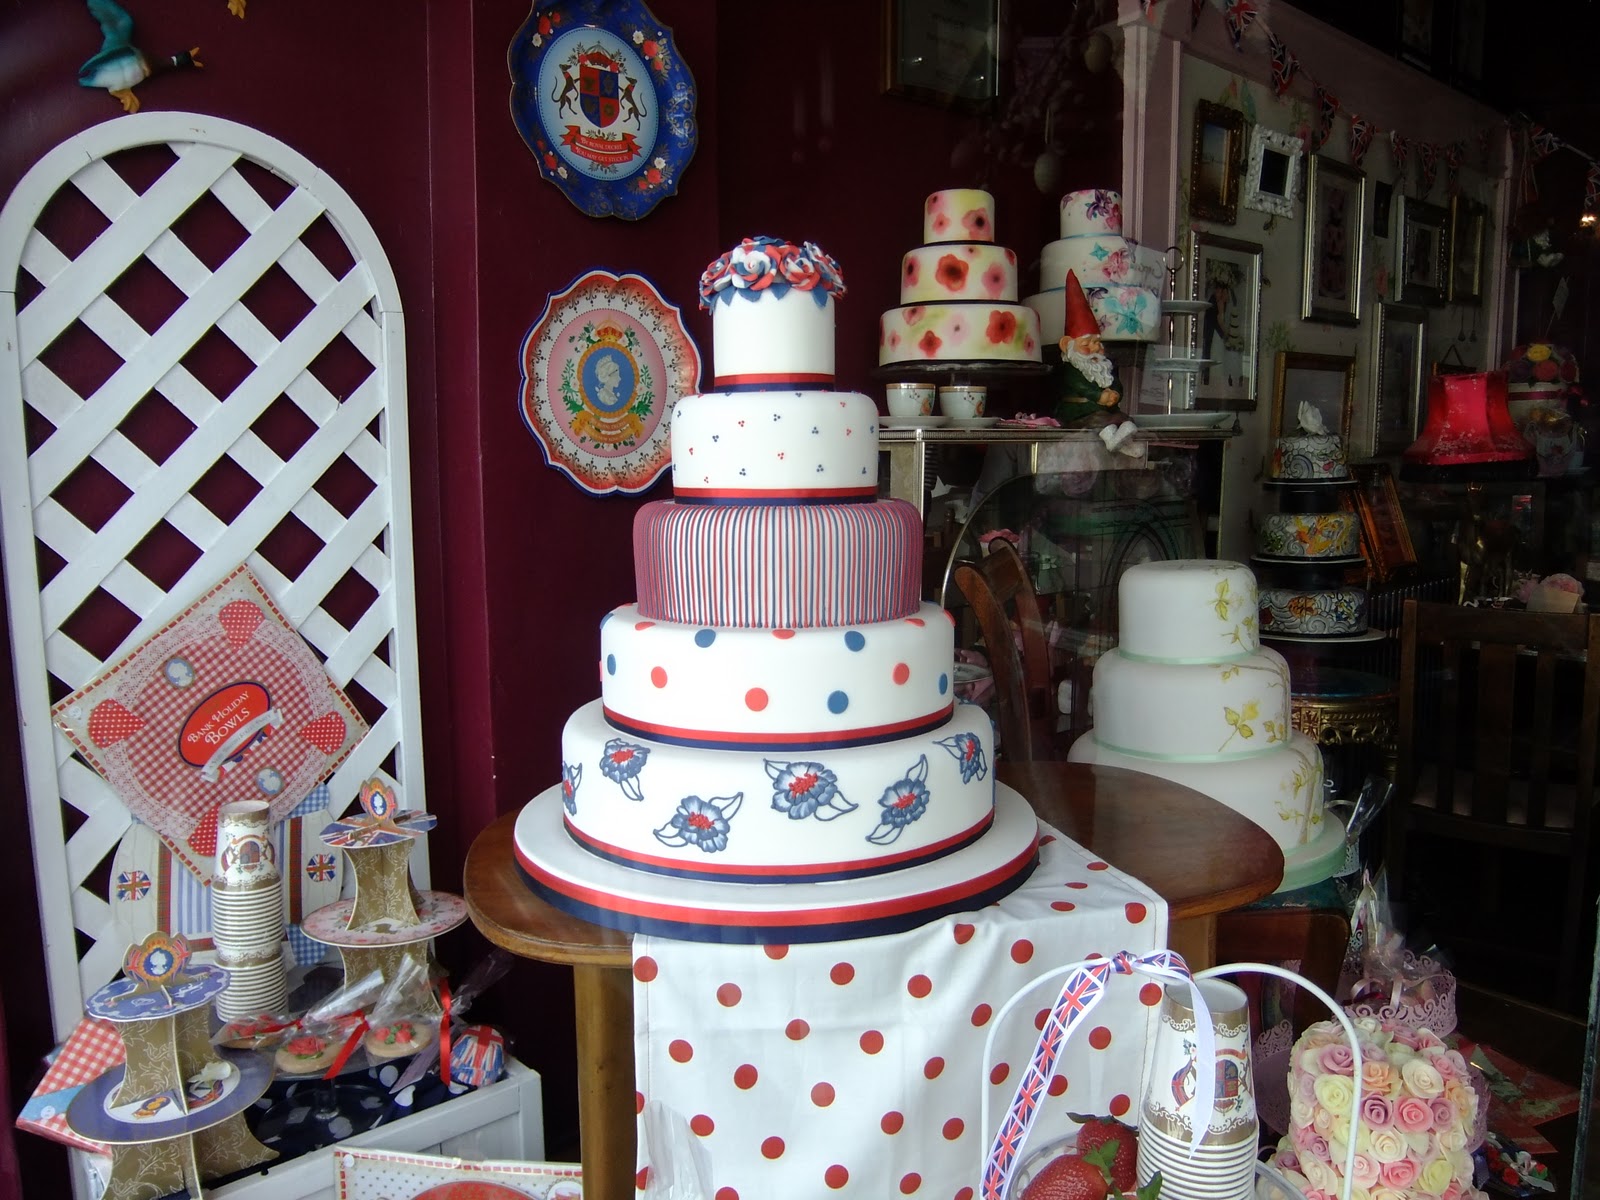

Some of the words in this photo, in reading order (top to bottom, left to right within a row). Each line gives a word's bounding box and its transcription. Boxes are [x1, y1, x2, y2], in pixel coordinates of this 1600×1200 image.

[187, 721, 215, 743] BANK
[211, 690, 250, 723] HOLIDAY
[204, 707, 251, 745] BOWLS
